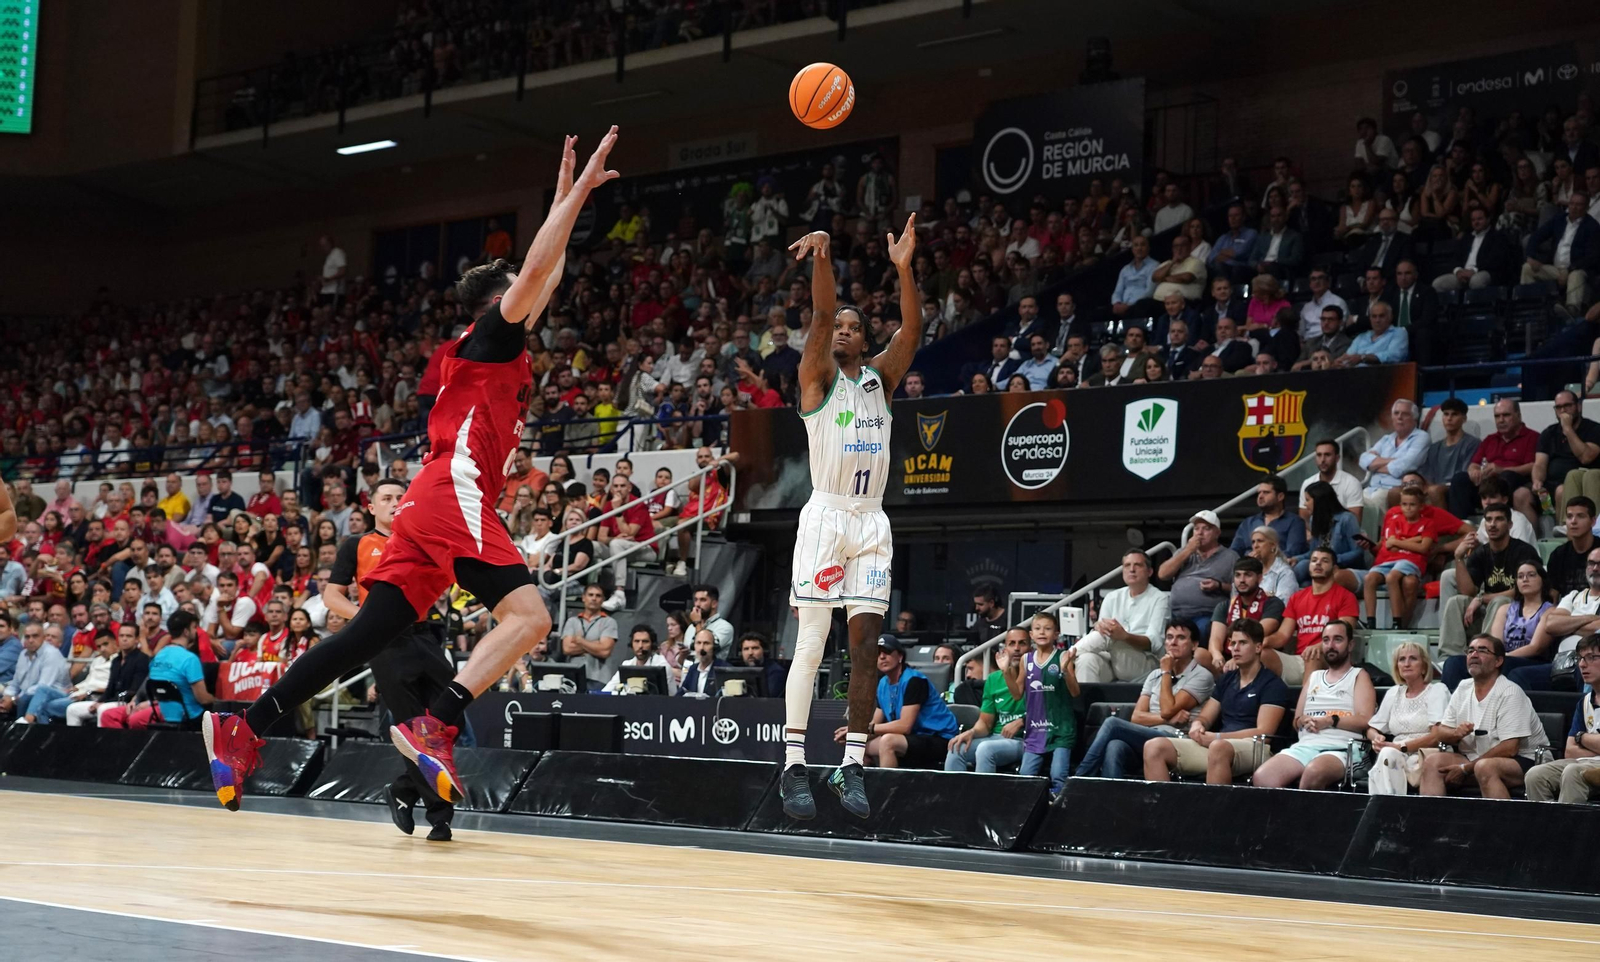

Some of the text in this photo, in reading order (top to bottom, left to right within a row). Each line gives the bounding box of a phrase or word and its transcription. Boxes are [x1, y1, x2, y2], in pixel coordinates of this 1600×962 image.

[679, 140, 747, 161] Grada Sur
[1042, 137, 1104, 162] REGIÓN
[1041, 152, 1131, 180] DE MURCIA
[855, 414, 885, 430] Unicaja
[1007, 433, 1064, 447] supercopa
[1130, 435, 1169, 446] Fundación
[1011, 444, 1063, 460] endesa
[1135, 446, 1163, 456] Unicaja
[904, 452, 953, 474] UCAM
[1129, 456, 1168, 465] Baloncesto
[855, 469, 871, 495] 11
[904, 473, 951, 484] UNIVERSIDAD
